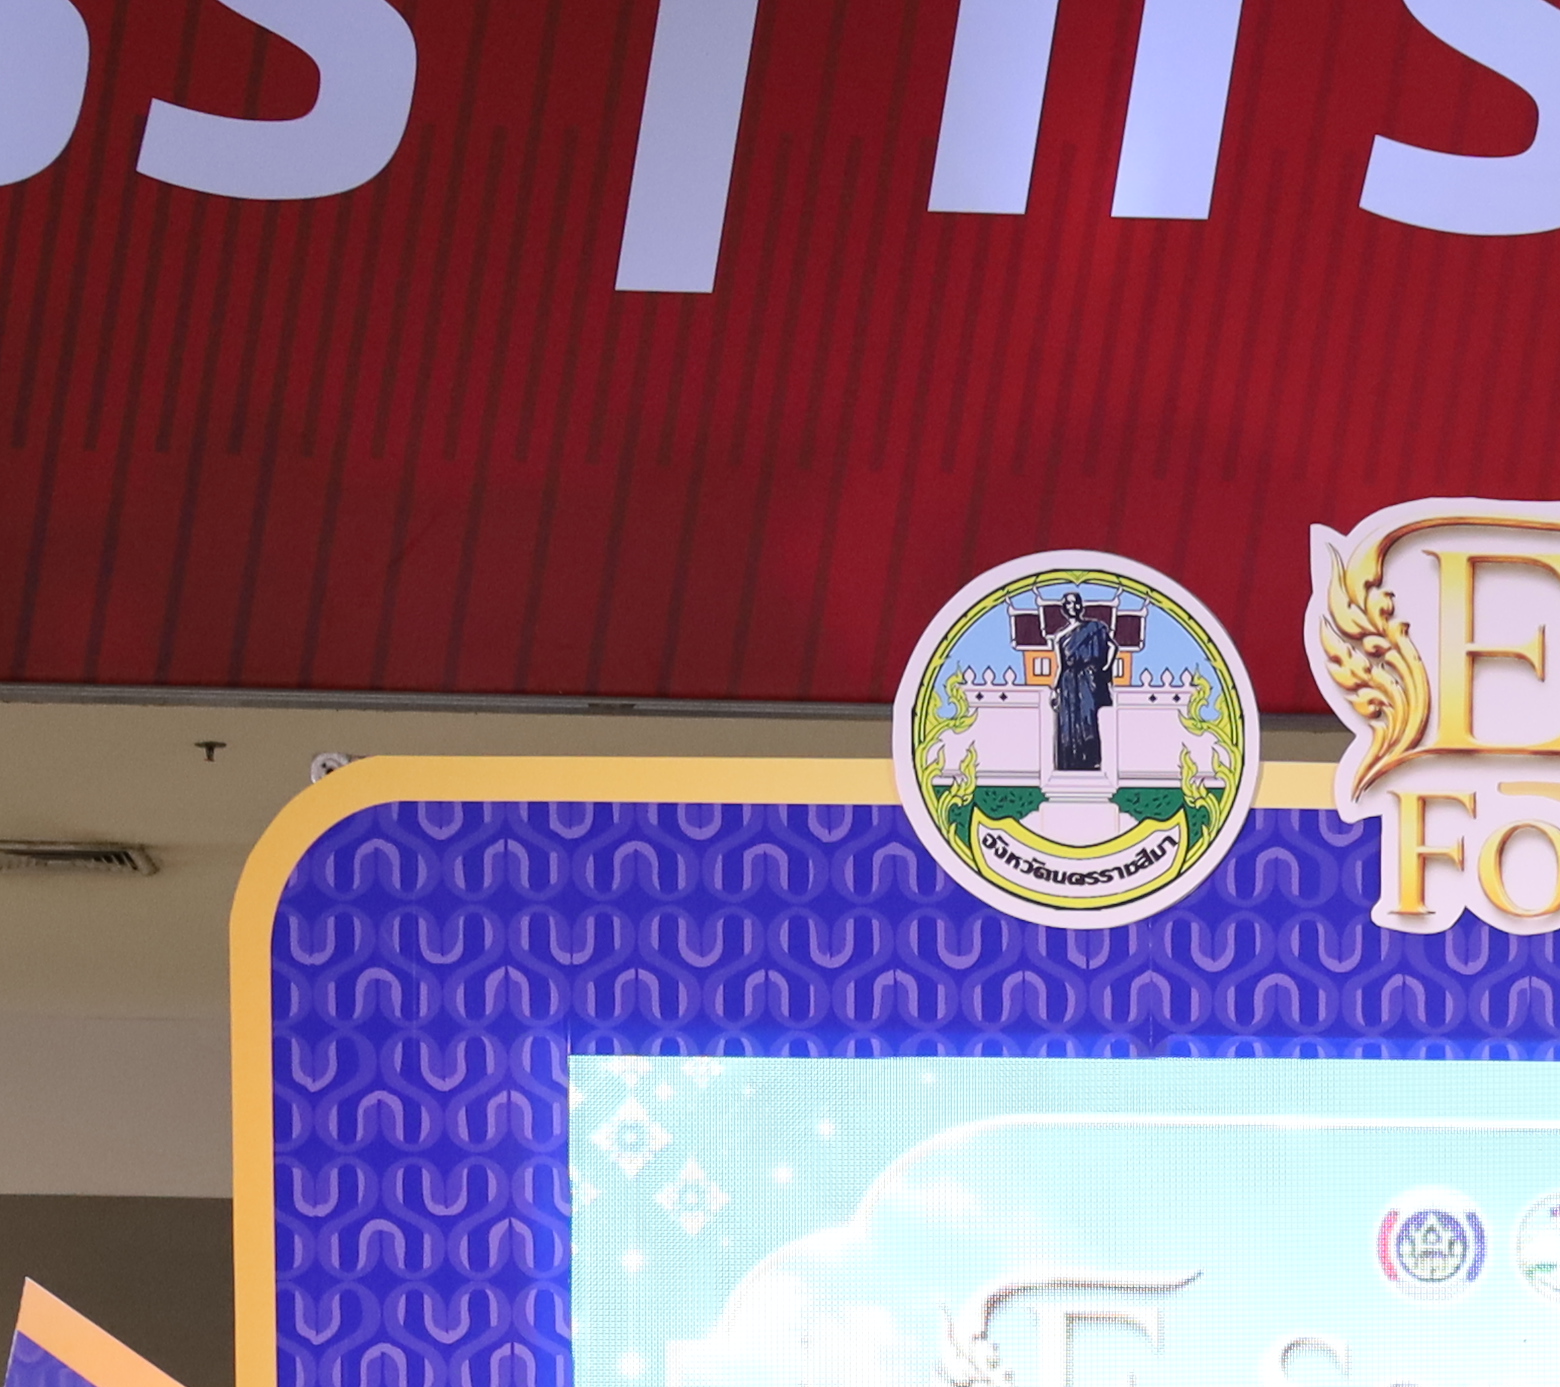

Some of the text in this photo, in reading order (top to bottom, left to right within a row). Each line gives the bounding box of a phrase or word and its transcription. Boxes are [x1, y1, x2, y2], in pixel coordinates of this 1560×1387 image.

[980, 832, 1180, 886] จังหวัดนครราชสีมา
